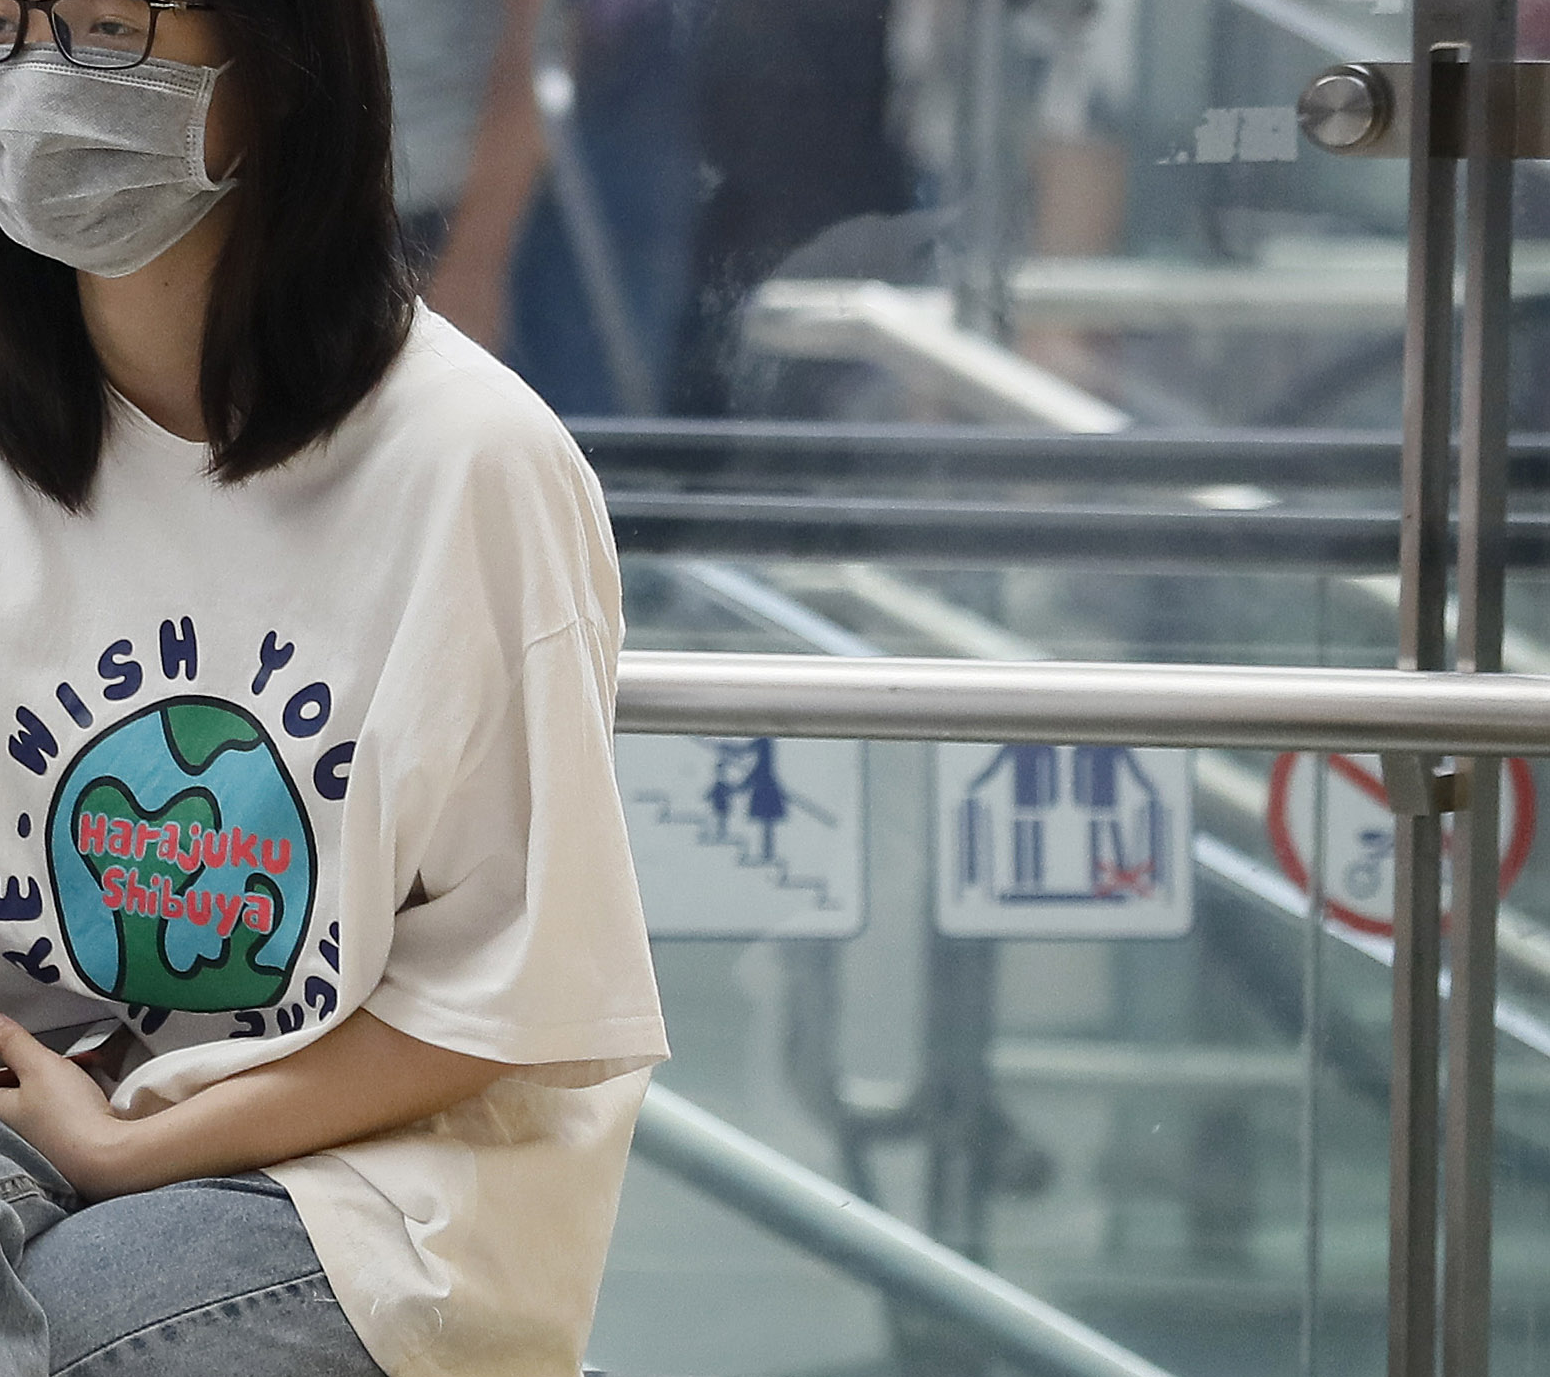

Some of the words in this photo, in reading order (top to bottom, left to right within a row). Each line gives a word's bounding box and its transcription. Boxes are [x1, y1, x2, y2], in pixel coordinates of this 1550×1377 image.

[7, 615, 199, 775] WISH
[78, 813, 292, 875] Harajuku
[101, 866, 274, 938] Shibuya
